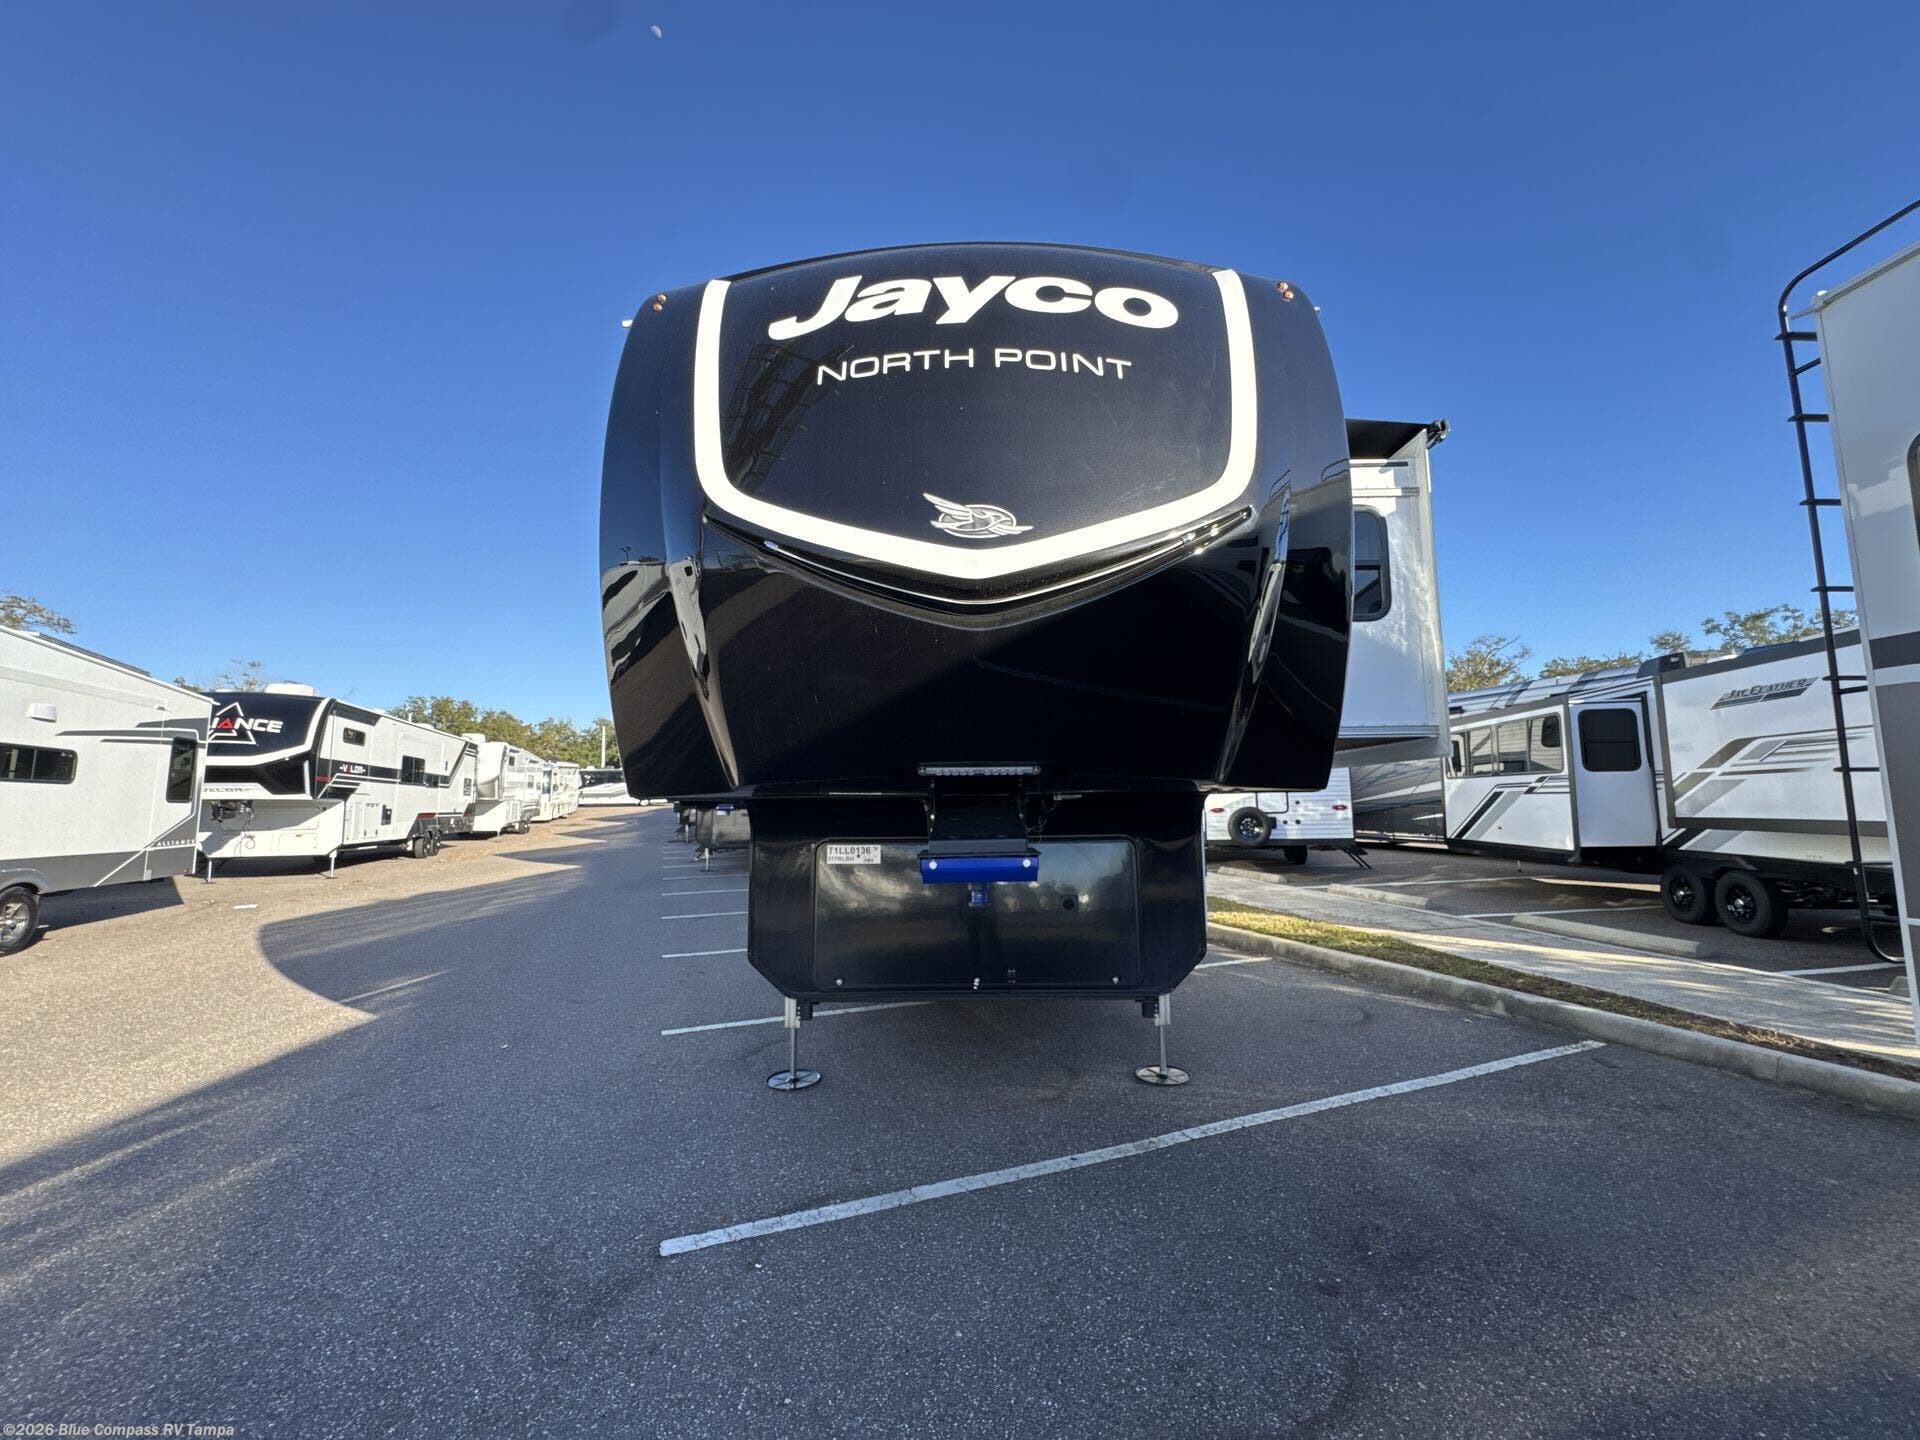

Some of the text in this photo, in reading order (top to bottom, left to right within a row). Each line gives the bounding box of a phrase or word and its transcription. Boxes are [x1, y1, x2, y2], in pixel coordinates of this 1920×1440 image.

[768, 275, 1179, 341] Jayco
[816, 347, 1133, 386] NORTH POINT
[828, 846, 872, 855] T1LL0136
